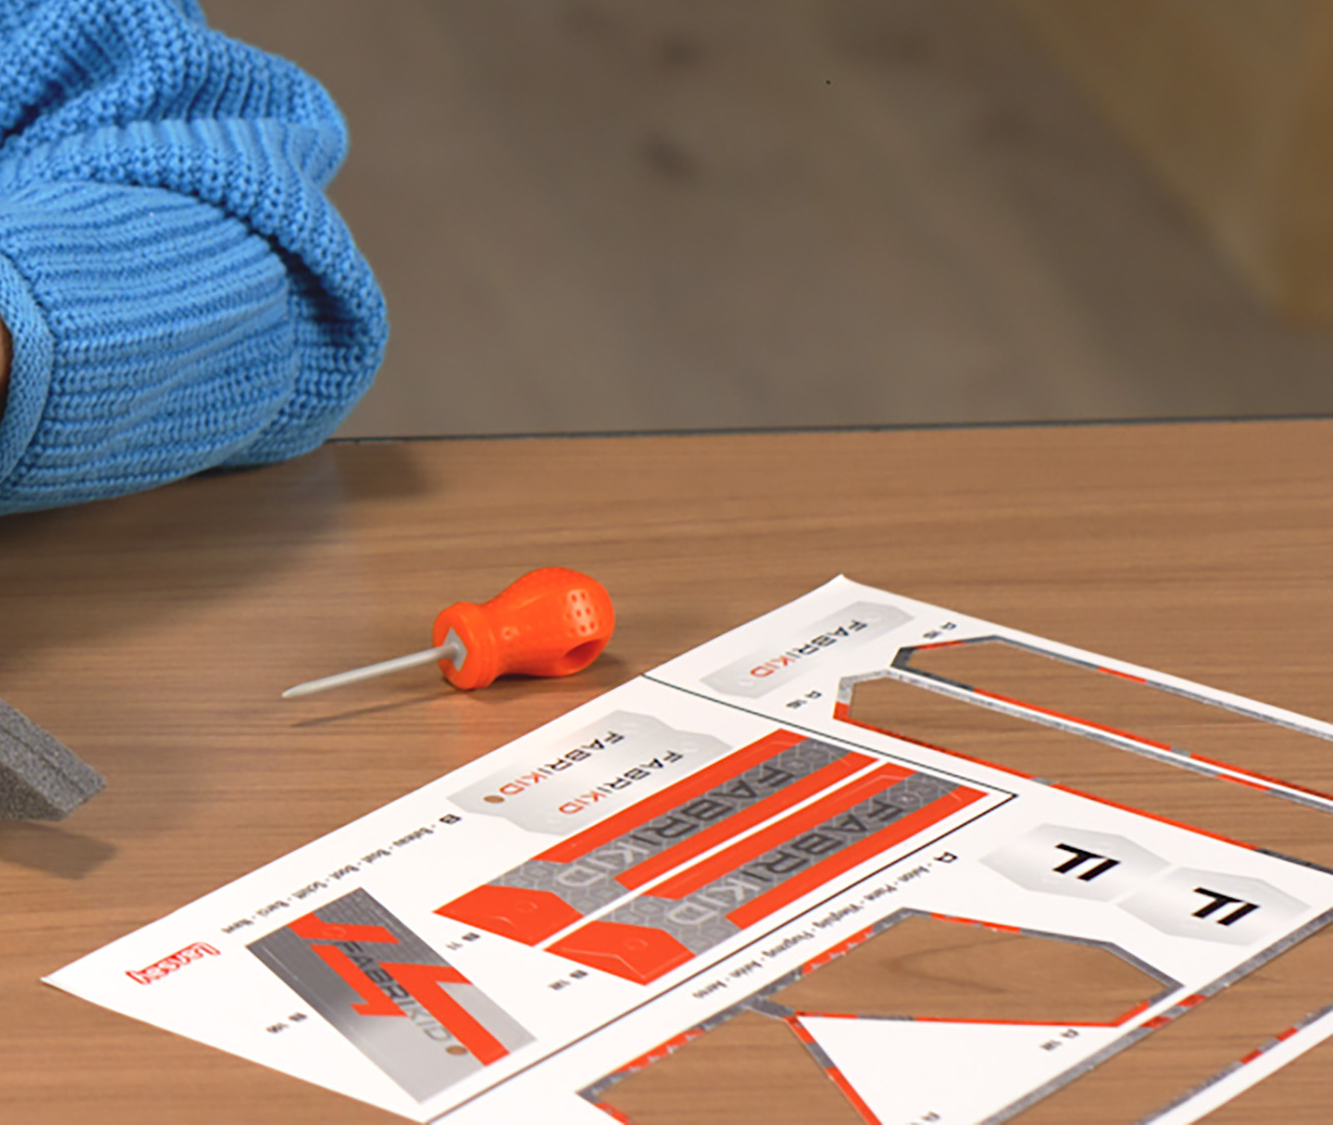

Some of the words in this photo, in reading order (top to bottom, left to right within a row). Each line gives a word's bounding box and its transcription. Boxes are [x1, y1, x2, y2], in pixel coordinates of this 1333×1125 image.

[749, 619, 869, 679] FABRIKID
[499, 730, 625, 796] FABRIKID
[558, 749, 683, 815] FABRIKID
[557, 765, 797, 888] FABRIKID
[667, 801, 907, 926] FABRIKID
[340, 941, 453, 1042] FABRIKID
